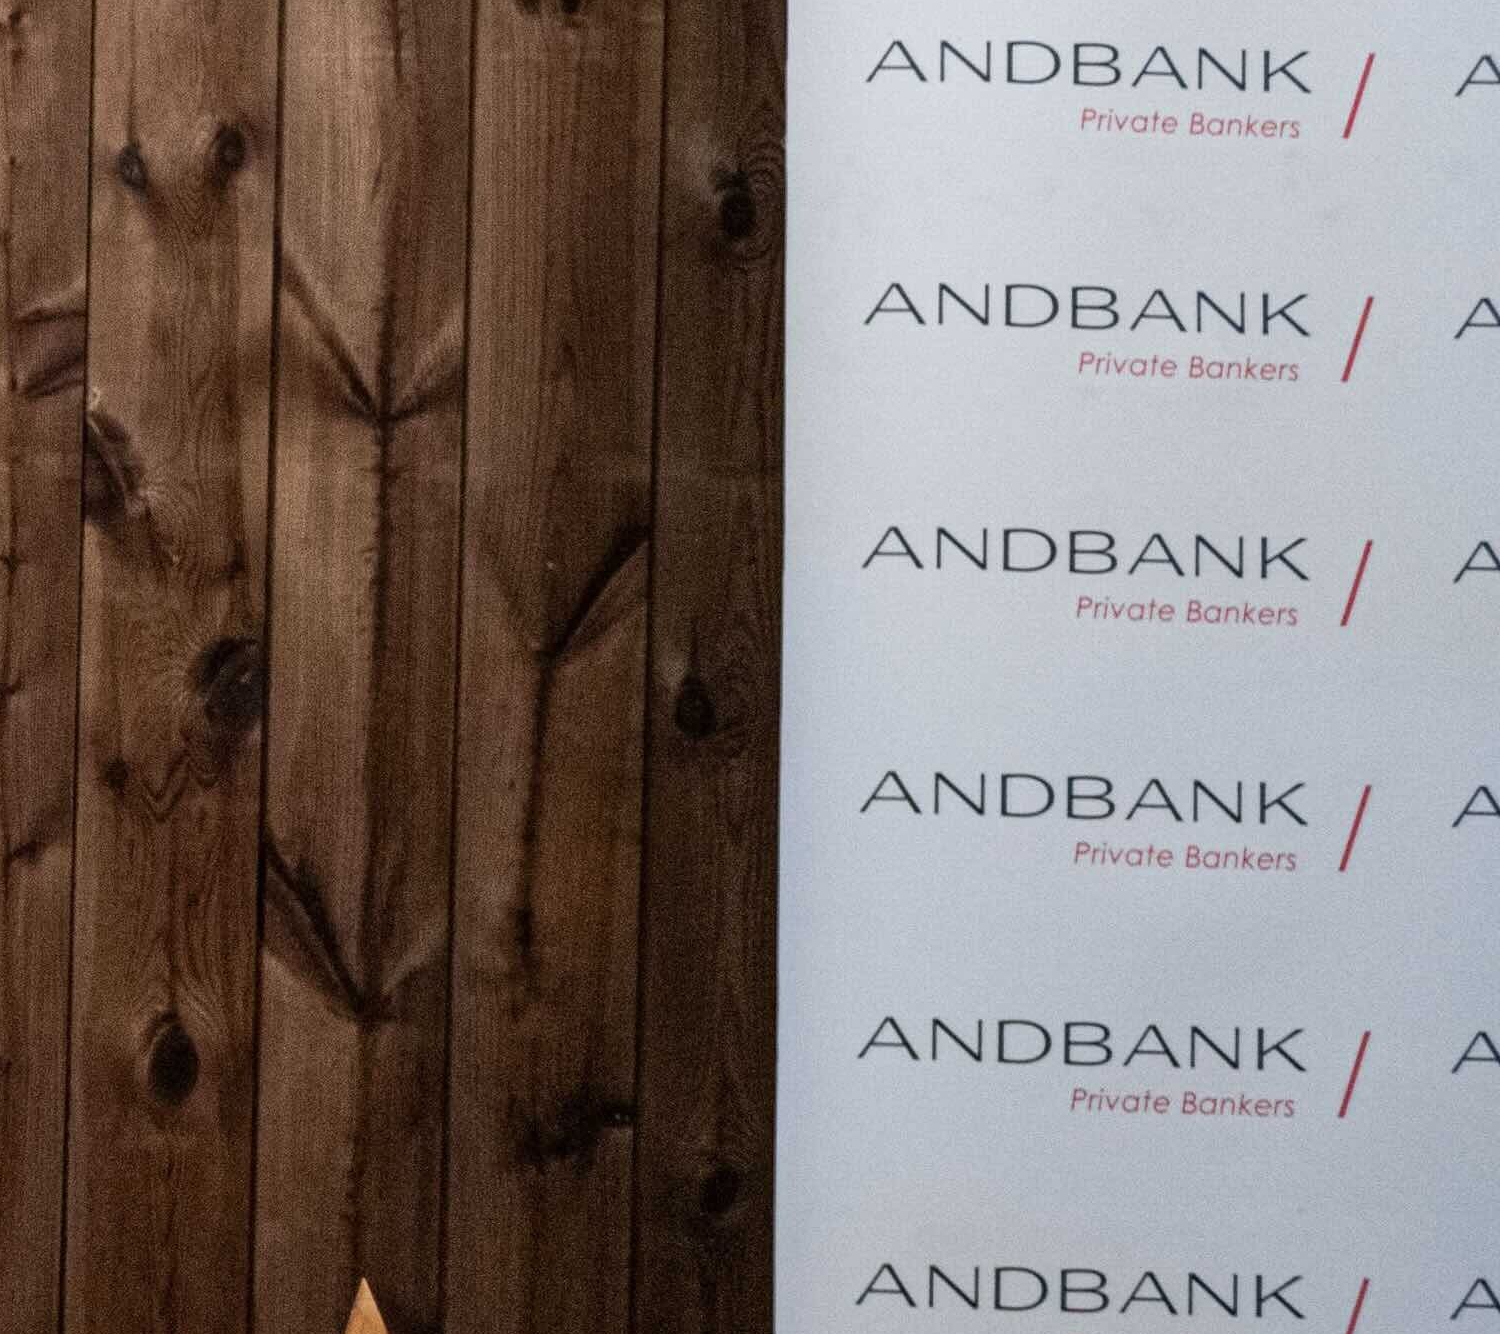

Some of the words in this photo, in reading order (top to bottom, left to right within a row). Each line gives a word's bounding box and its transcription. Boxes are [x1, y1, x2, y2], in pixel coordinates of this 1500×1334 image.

[866, 40, 1311, 94] ANDBANK
[1080, 108, 1179, 135] Private
[1189, 110, 1301, 138] Bankers
[864, 282, 1310, 337] ANDBANK
[1078, 352, 1177, 378] Private
[1189, 354, 1300, 382] Bankers
[862, 526, 1309, 581] ANDBANK
[1076, 596, 1175, 623] Private
[1186, 599, 1299, 627] Bankers
[860, 769, 1308, 826] ANDBANK
[1073, 842, 1174, 869] Private
[1185, 844, 1298, 872] Bankers
[856, 1016, 1306, 1072] ANDBANK
[1070, 1088, 1171, 1115] Private
[1182, 1090, 1296, 1118] Bankers
[855, 1263, 1306, 1320] ANDBANK
